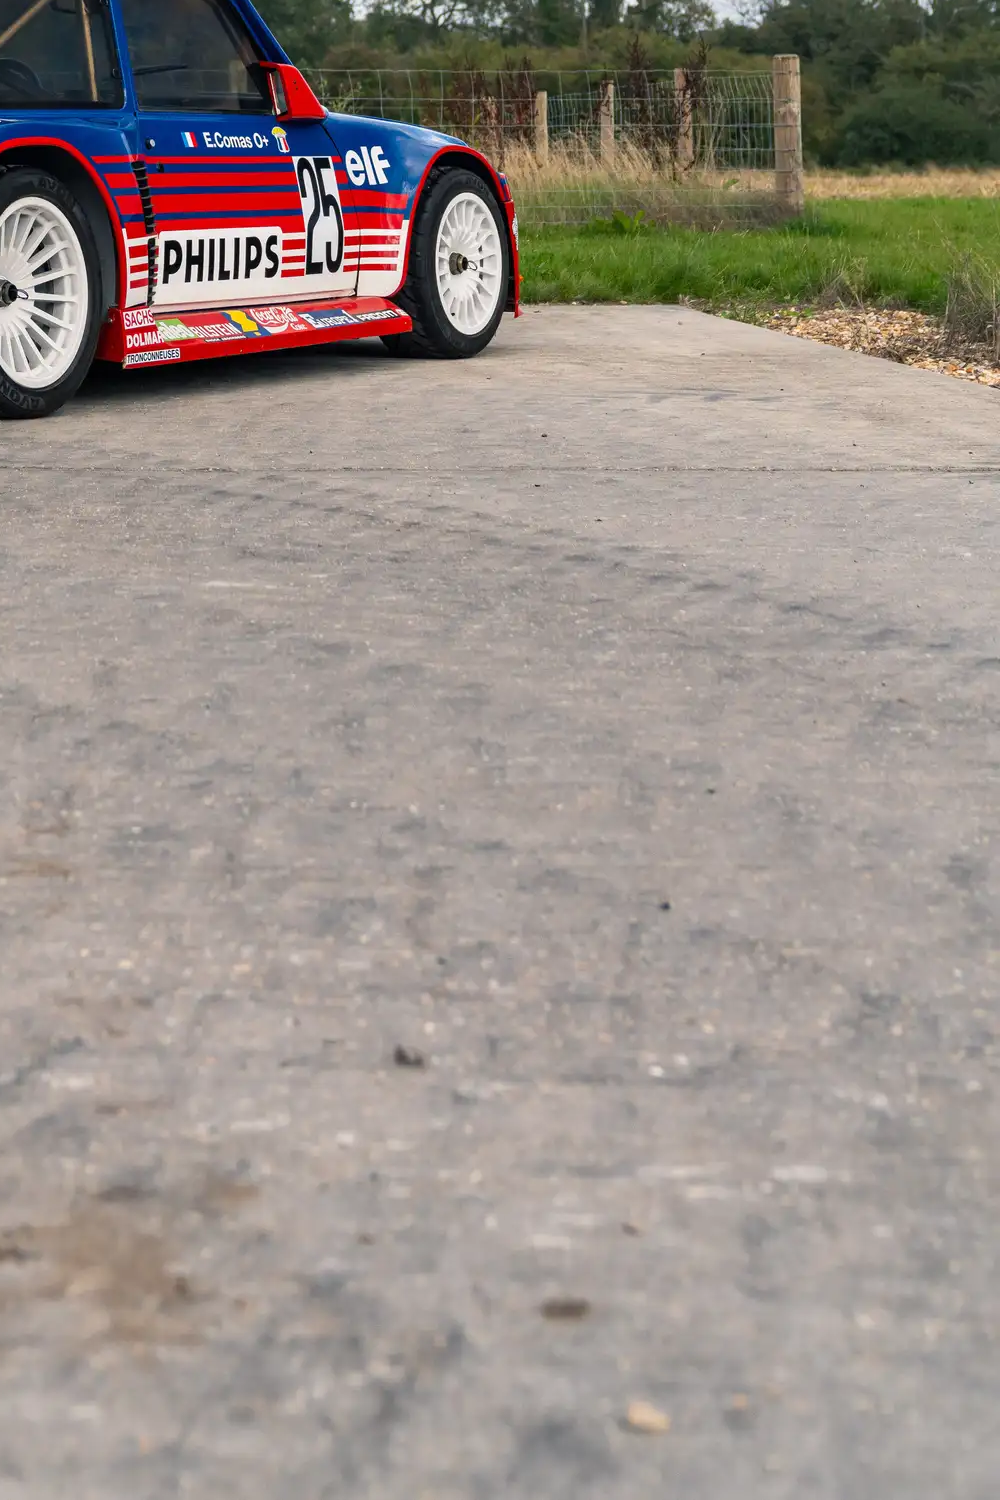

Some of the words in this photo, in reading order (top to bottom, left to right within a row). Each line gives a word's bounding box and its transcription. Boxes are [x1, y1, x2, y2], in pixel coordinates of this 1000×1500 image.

[203, 132, 253, 148] E.Comas
[254, 133, 269, 148] O+
[345, 146, 391, 186] elf
[296, 156, 344, 275] 25
[162, 235, 280, 284] PHILIPS
[124, 309, 154, 328] SACHS
[126, 330, 165, 348] DOLMAR
[188, 322, 243, 338] BILSTEIN
